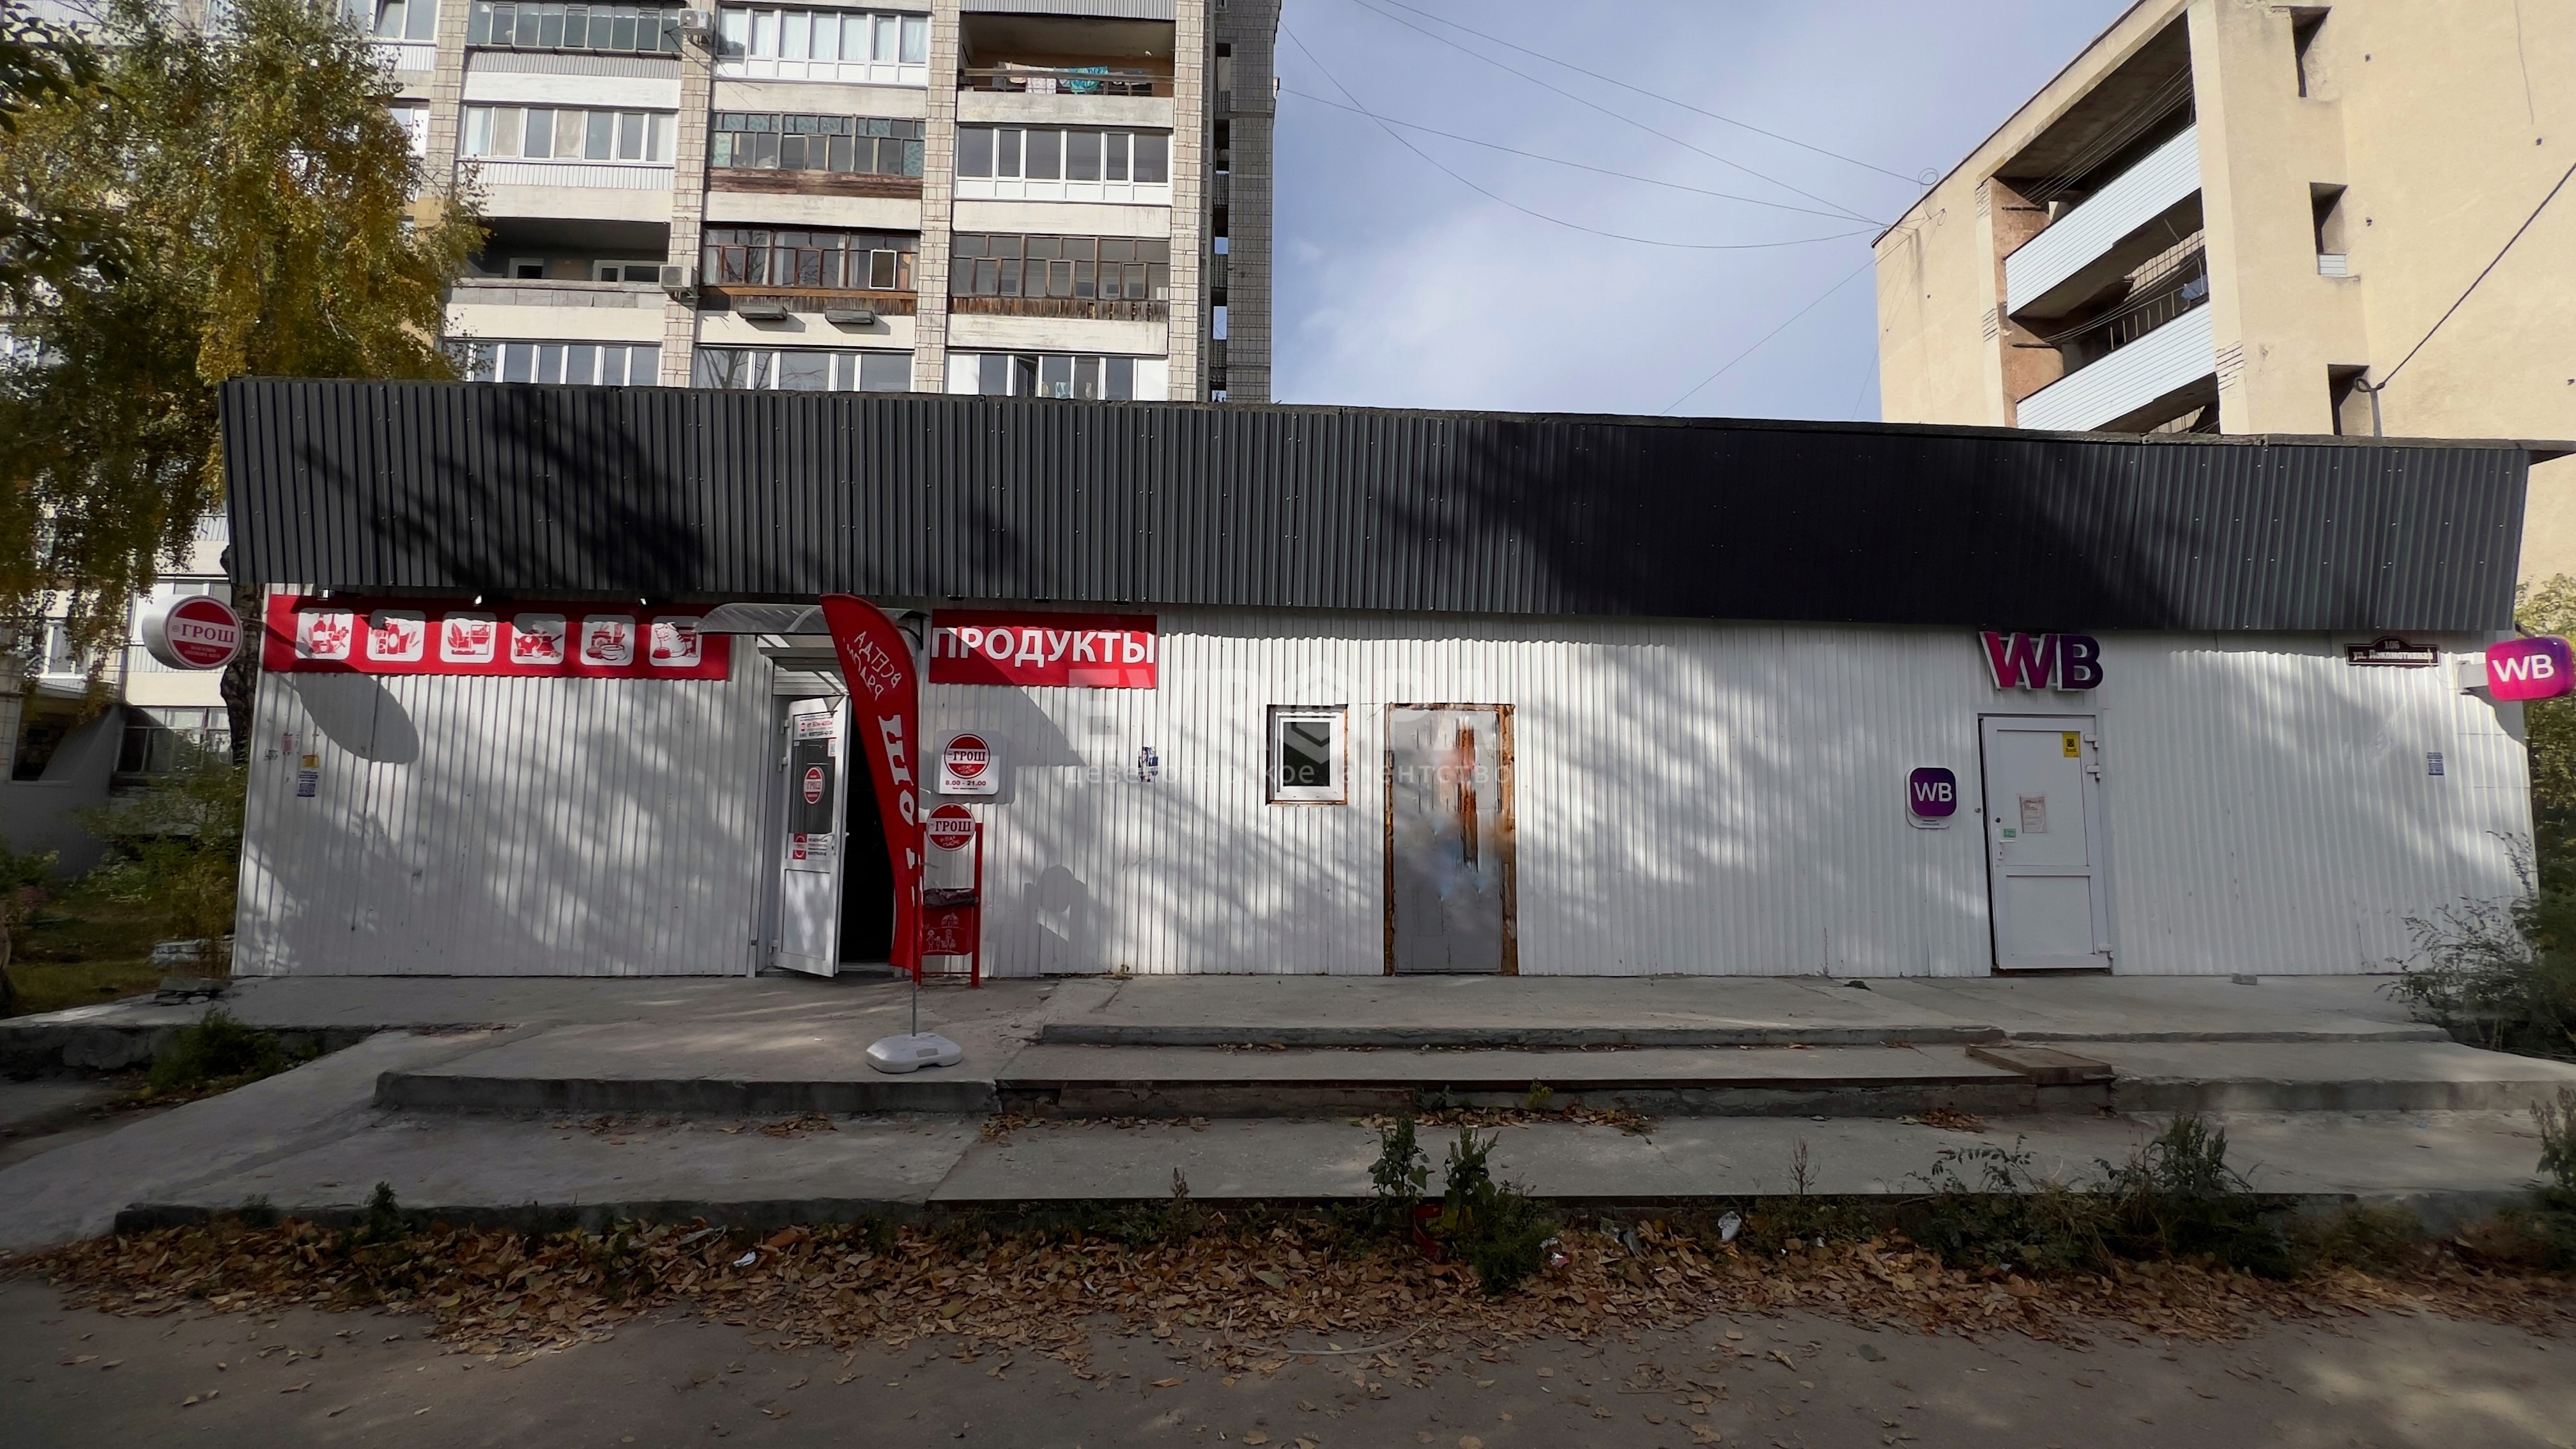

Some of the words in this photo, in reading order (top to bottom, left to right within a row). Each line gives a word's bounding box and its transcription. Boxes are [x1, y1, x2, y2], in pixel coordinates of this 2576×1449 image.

[181, 624, 234, 643] ГРОШ
[931, 627, 1155, 668] ПРОДУКТЫ
[1979, 631, 2103, 691] WB
[2492, 654, 2555, 682] WB
[953, 751, 986, 761] ГРОШ
[1913, 781, 1952, 802] WB
[935, 820, 971, 832] ГРОШ
